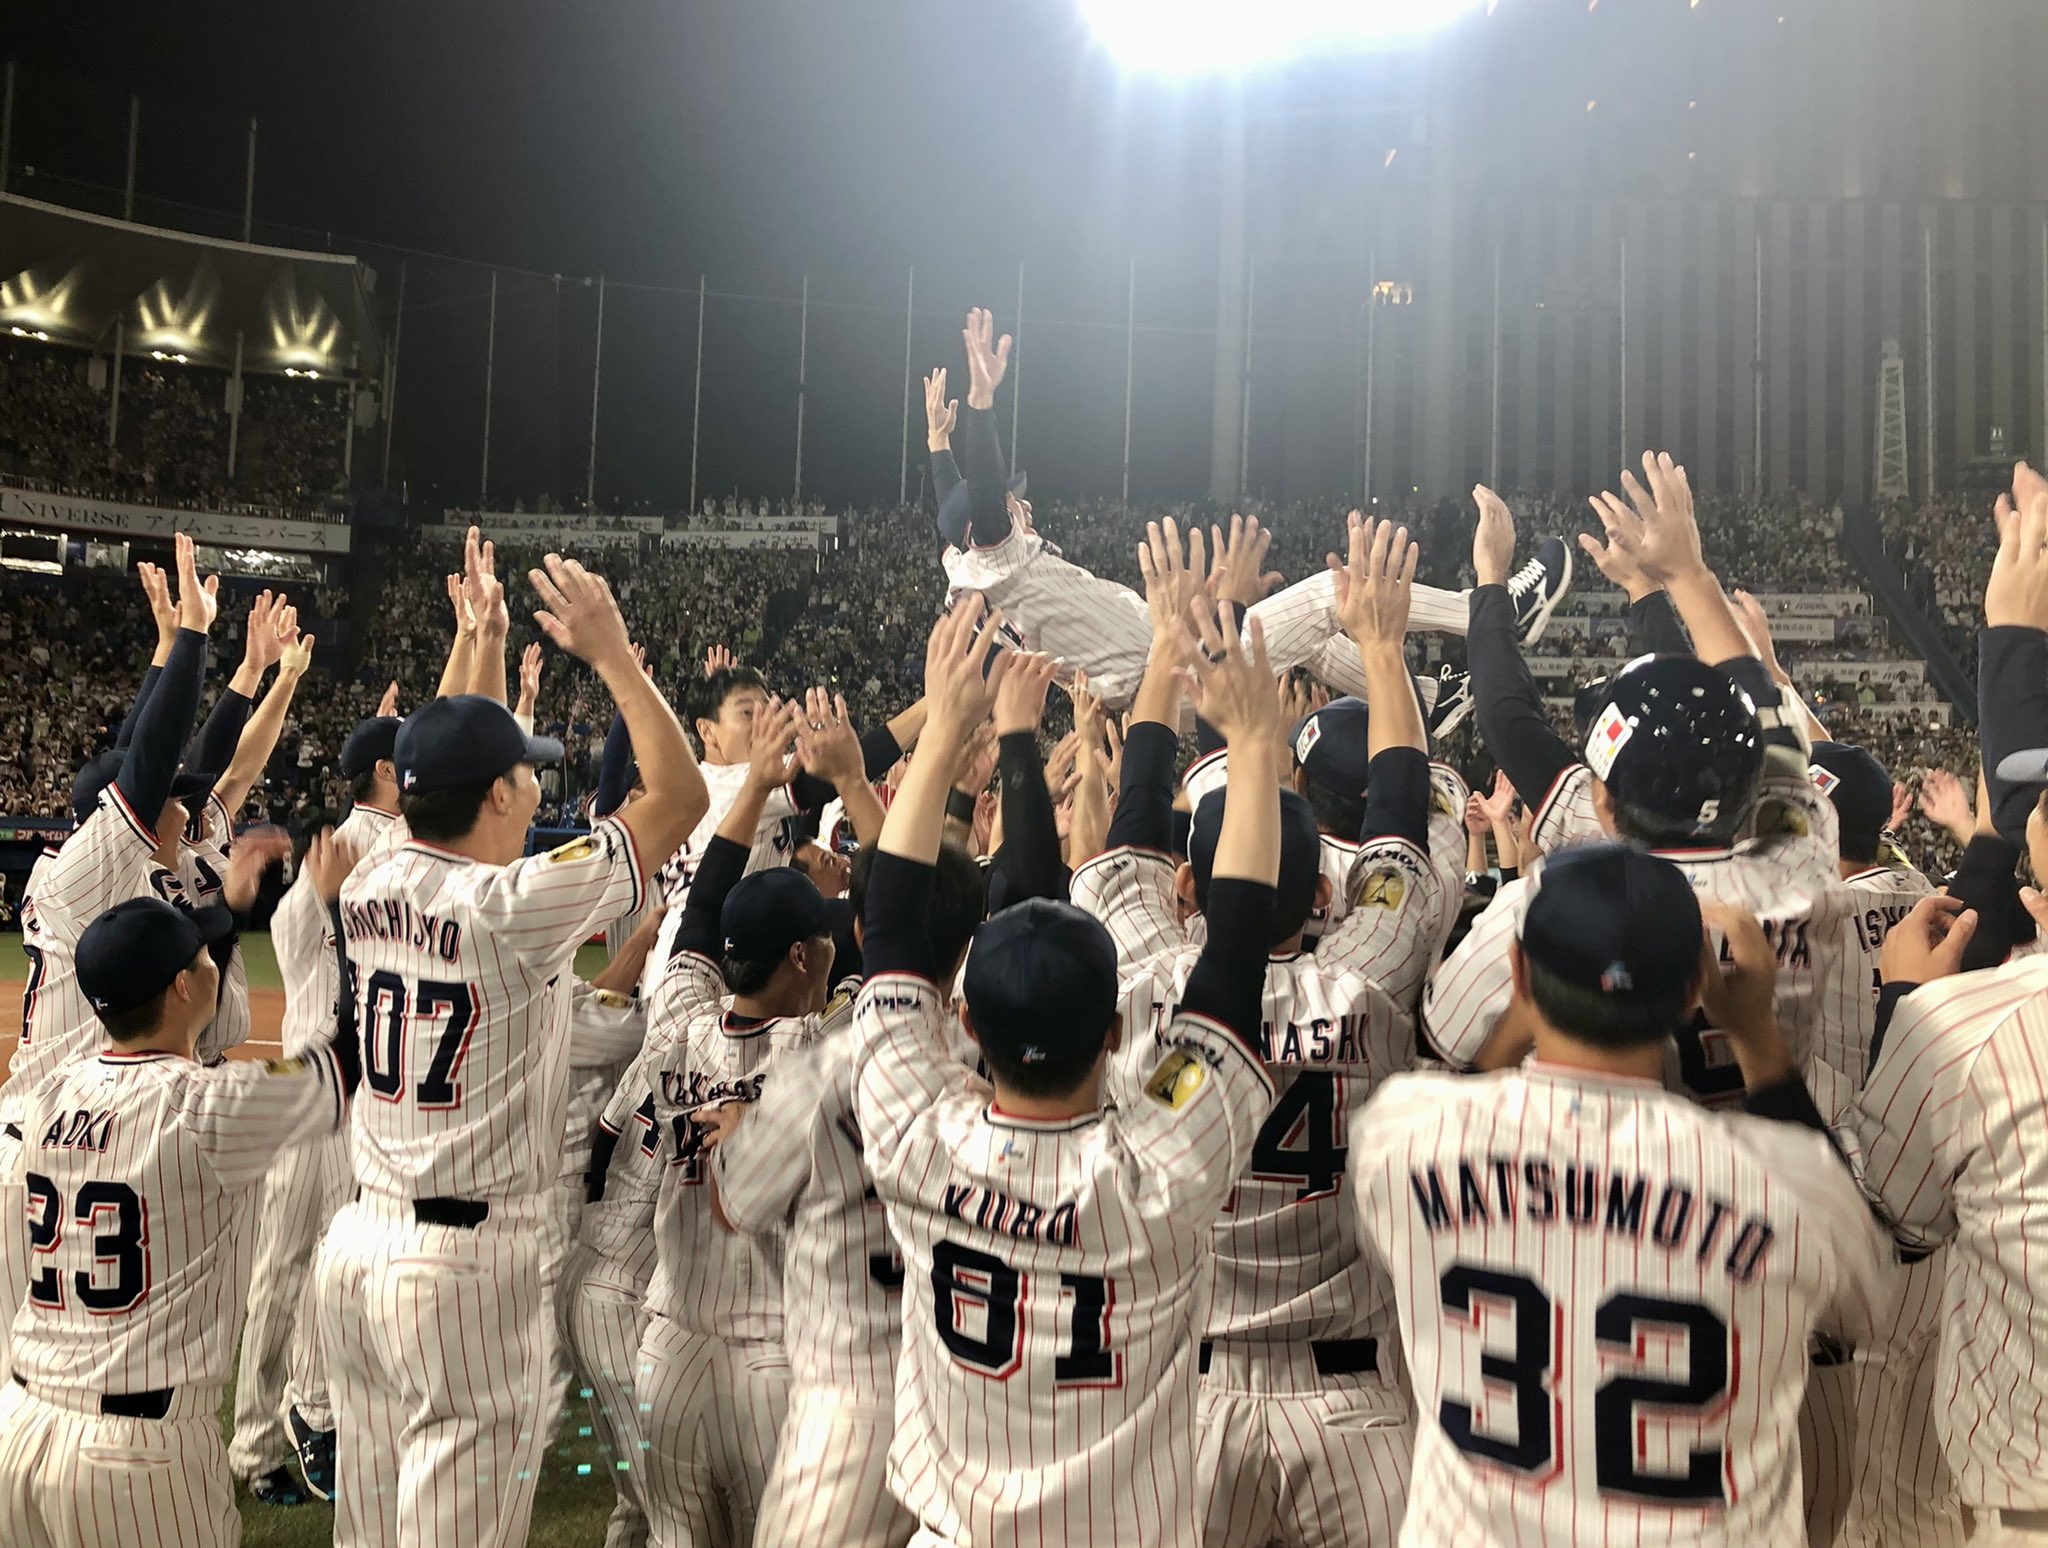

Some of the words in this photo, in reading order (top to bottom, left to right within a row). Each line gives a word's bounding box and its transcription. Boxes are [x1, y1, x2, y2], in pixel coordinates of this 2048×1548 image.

[1697, 799, 1720, 825] 5
[347, 957, 481, 1112] 07
[41, 1109, 118, 1153] AOKI
[1252, 1070, 1350, 1205] 4
[26, 1171, 150, 1316] 23
[1411, 1149, 1775, 1285] MATSUMOTO
[1438, 1264, 1741, 1511] 32
